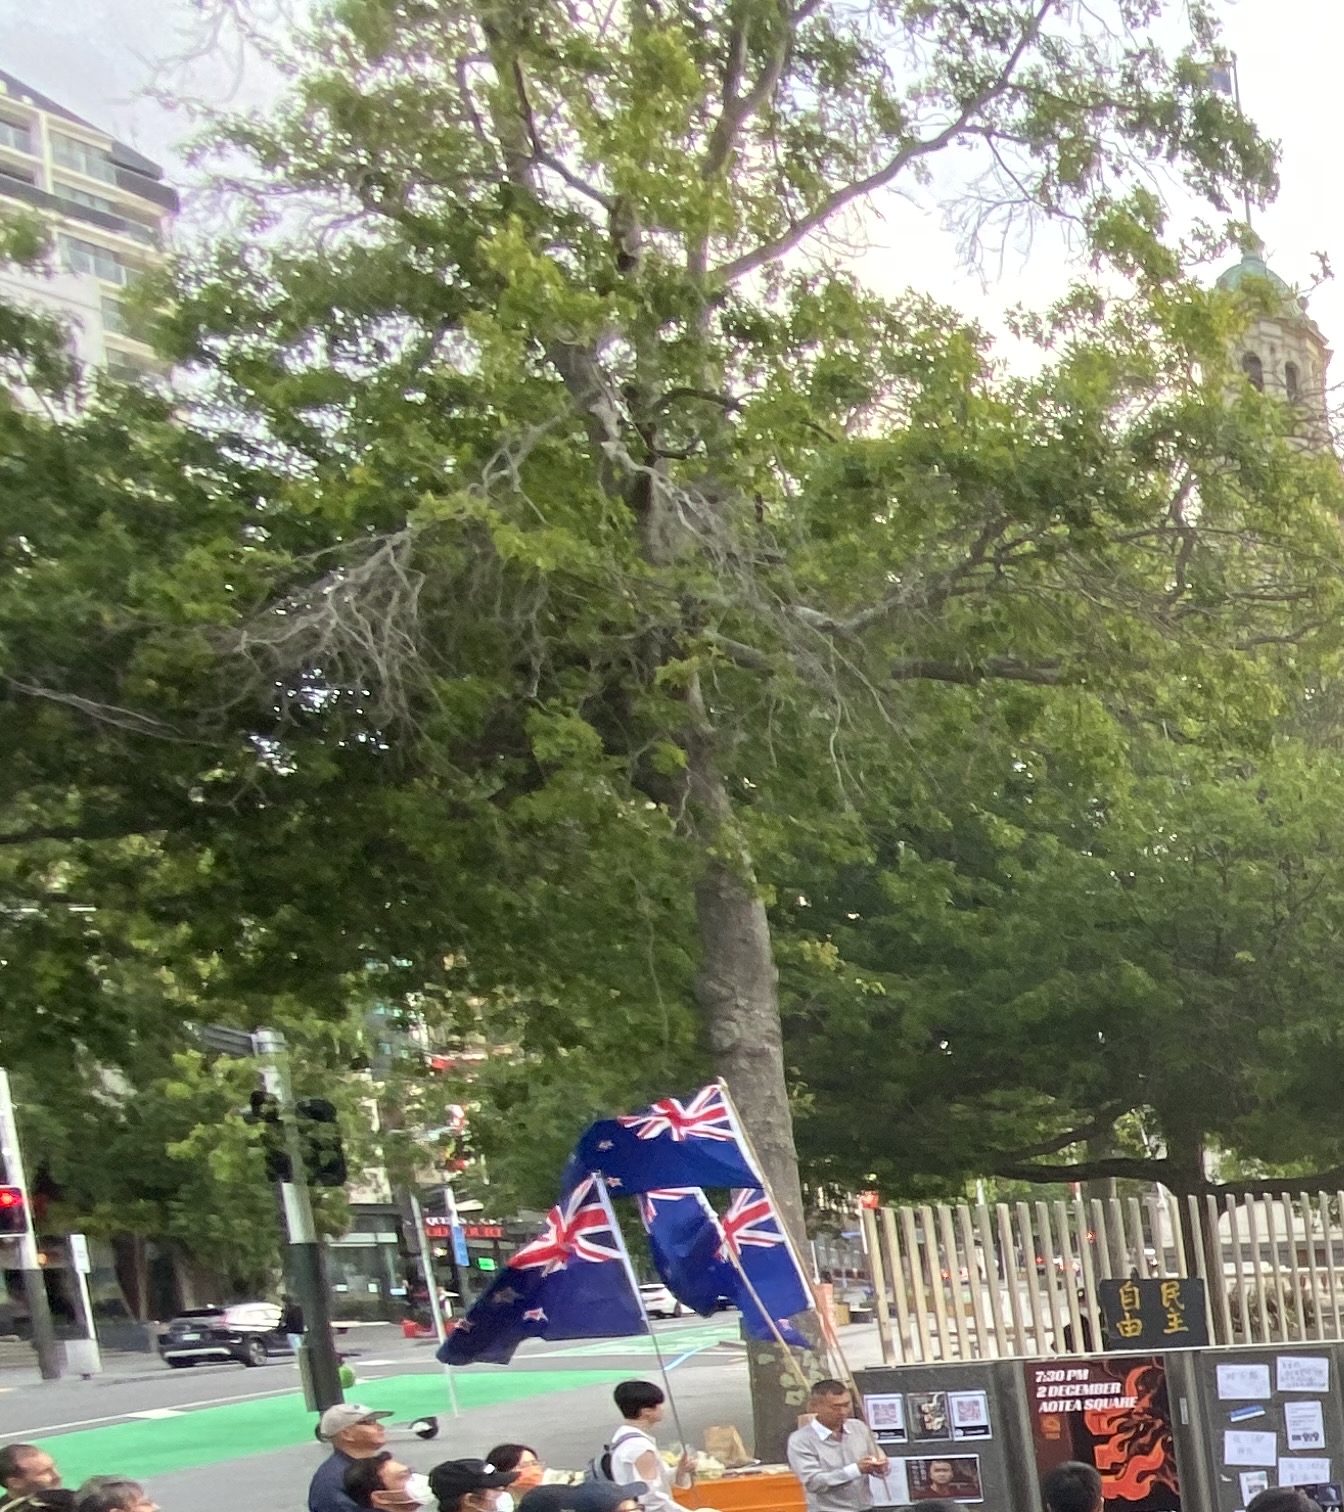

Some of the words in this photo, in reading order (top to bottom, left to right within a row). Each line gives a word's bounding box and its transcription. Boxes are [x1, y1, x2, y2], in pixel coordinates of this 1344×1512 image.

[1035, 1369, 1065, 1383] 7:30
[1066, 1368, 1089, 1382] PM
[1037, 1386, 1047, 1398] 2
[1048, 1382, 1122, 1398] DECEMBER
[1039, 1398, 1082, 1413] AOTEA
[1083, 1396, 1138, 1412] SQUARE
